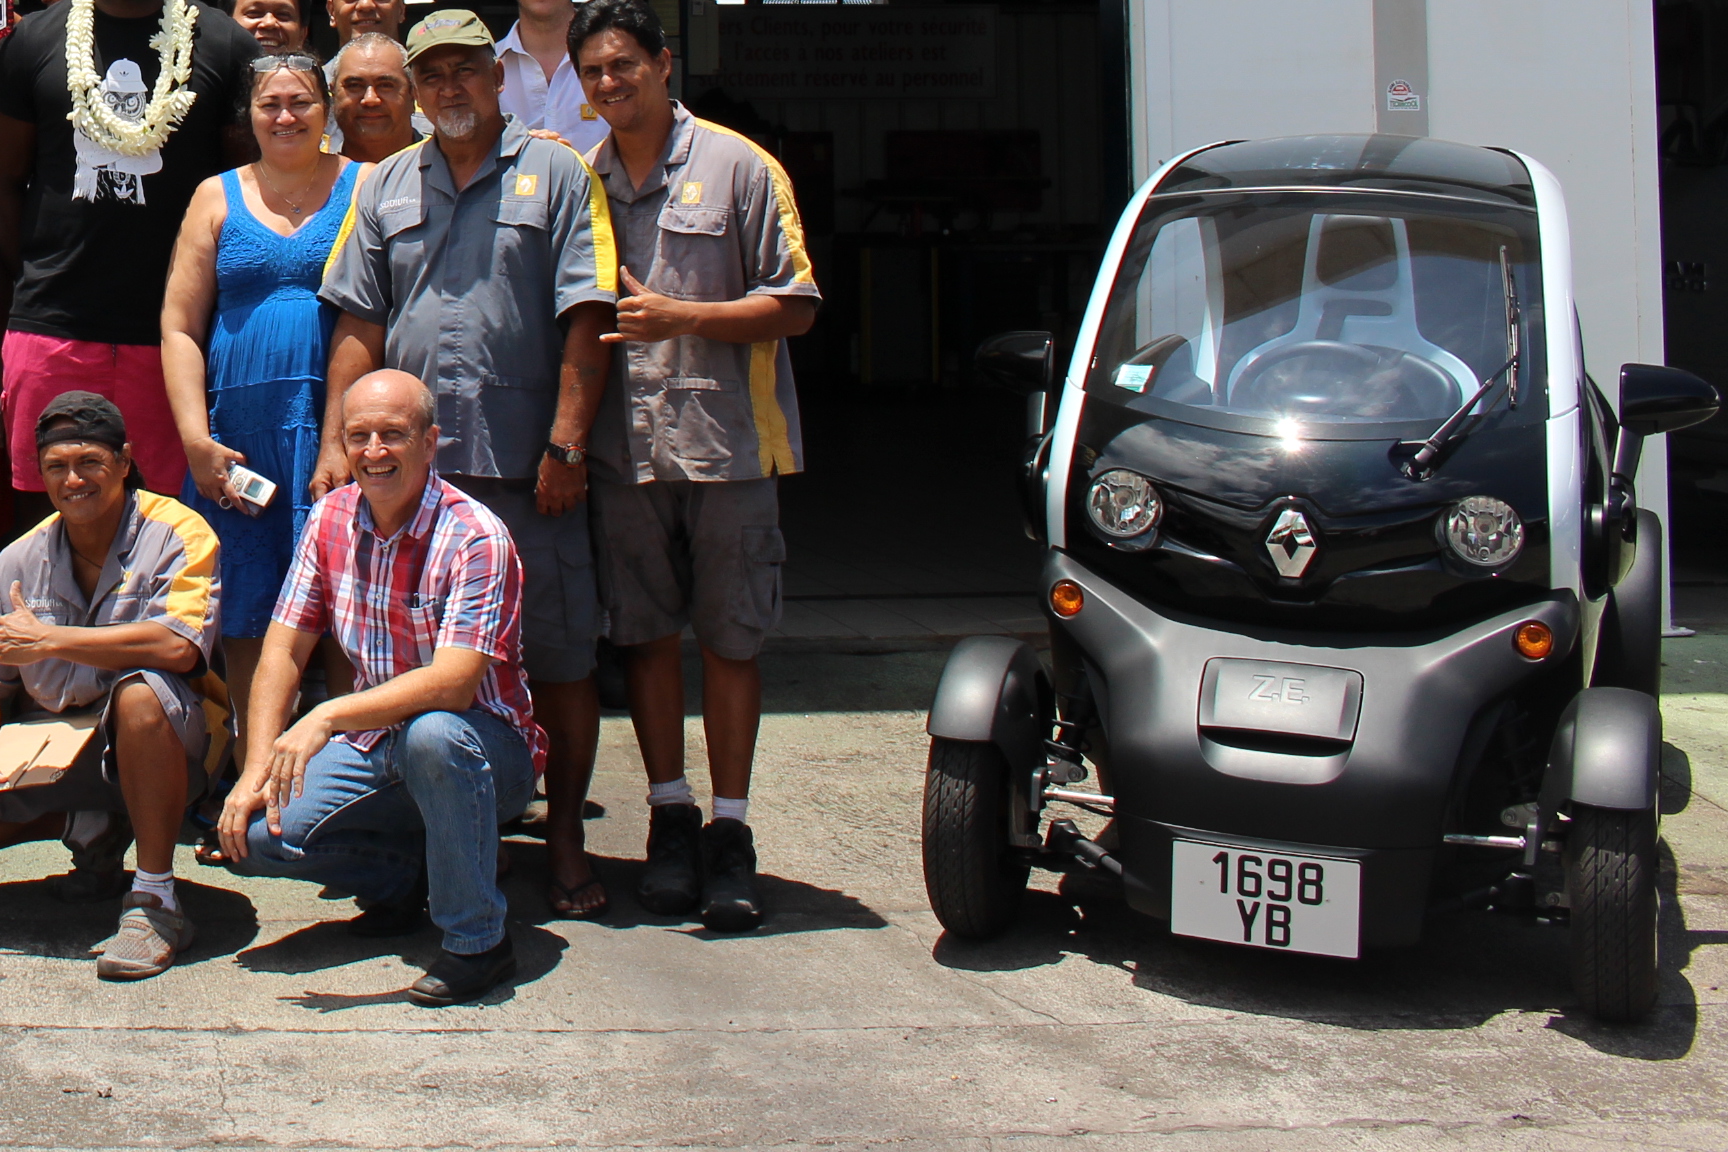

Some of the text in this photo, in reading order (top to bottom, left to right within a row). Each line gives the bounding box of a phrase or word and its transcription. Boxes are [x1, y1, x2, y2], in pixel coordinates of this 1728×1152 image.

[751, 16, 814, 38] Clients,
[821, 20, 860, 41] pour
[869, 18, 913, 36] votre
[921, 15, 987, 36] sécurité
[735, 41, 946, 61] l'accès à nos ateliers est
[805, 68, 867, 87] réservé
[876, 74, 894, 87] au
[903, 68, 984, 92] personnel
[1248, 674, 1310, 705] Z.E.
[1213, 851, 1324, 905] 1698
[1236, 899, 1292, 947] YB
